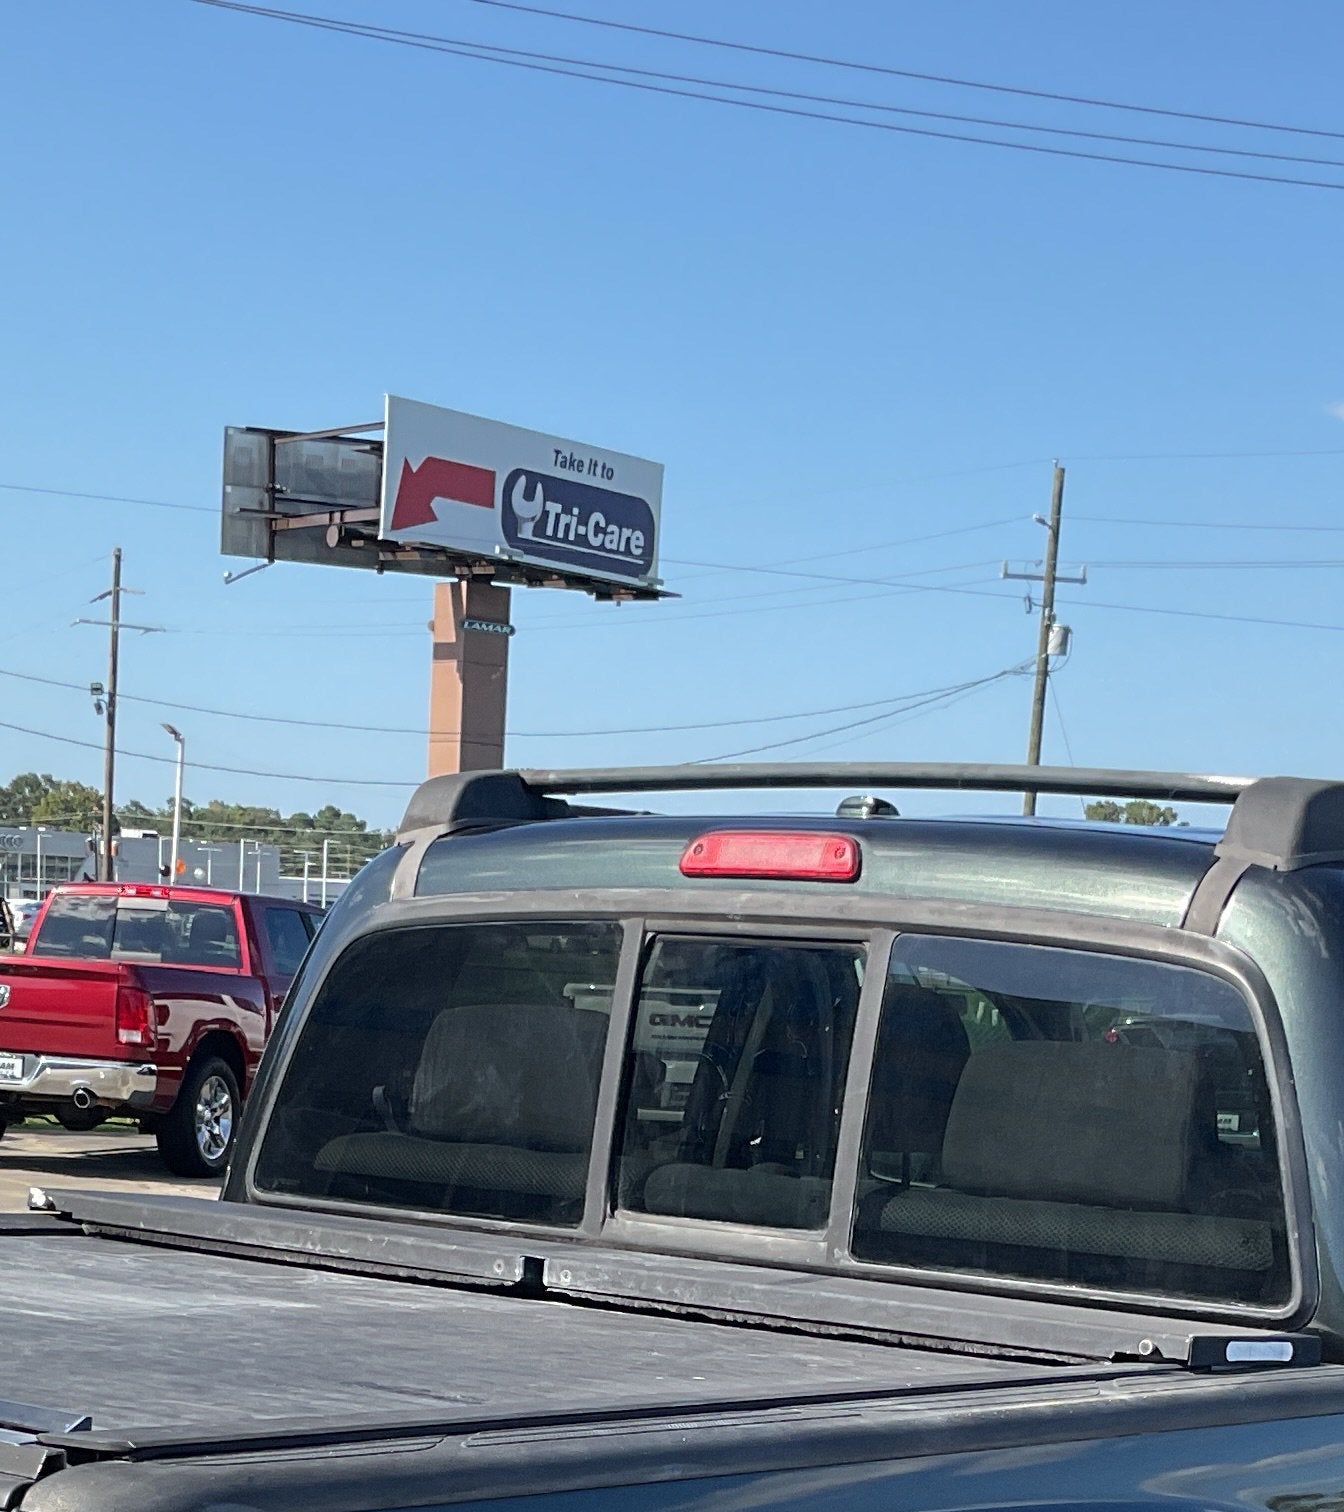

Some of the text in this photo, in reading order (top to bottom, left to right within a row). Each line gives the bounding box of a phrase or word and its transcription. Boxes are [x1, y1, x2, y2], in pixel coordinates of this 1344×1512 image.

[553, 449, 585, 473] Take
[600, 462, 614, 481] to
[545, 501, 645, 556] Tri-Care
[463, 621, 512, 634] LAMAR
[649, 1013, 713, 1028] GMC
